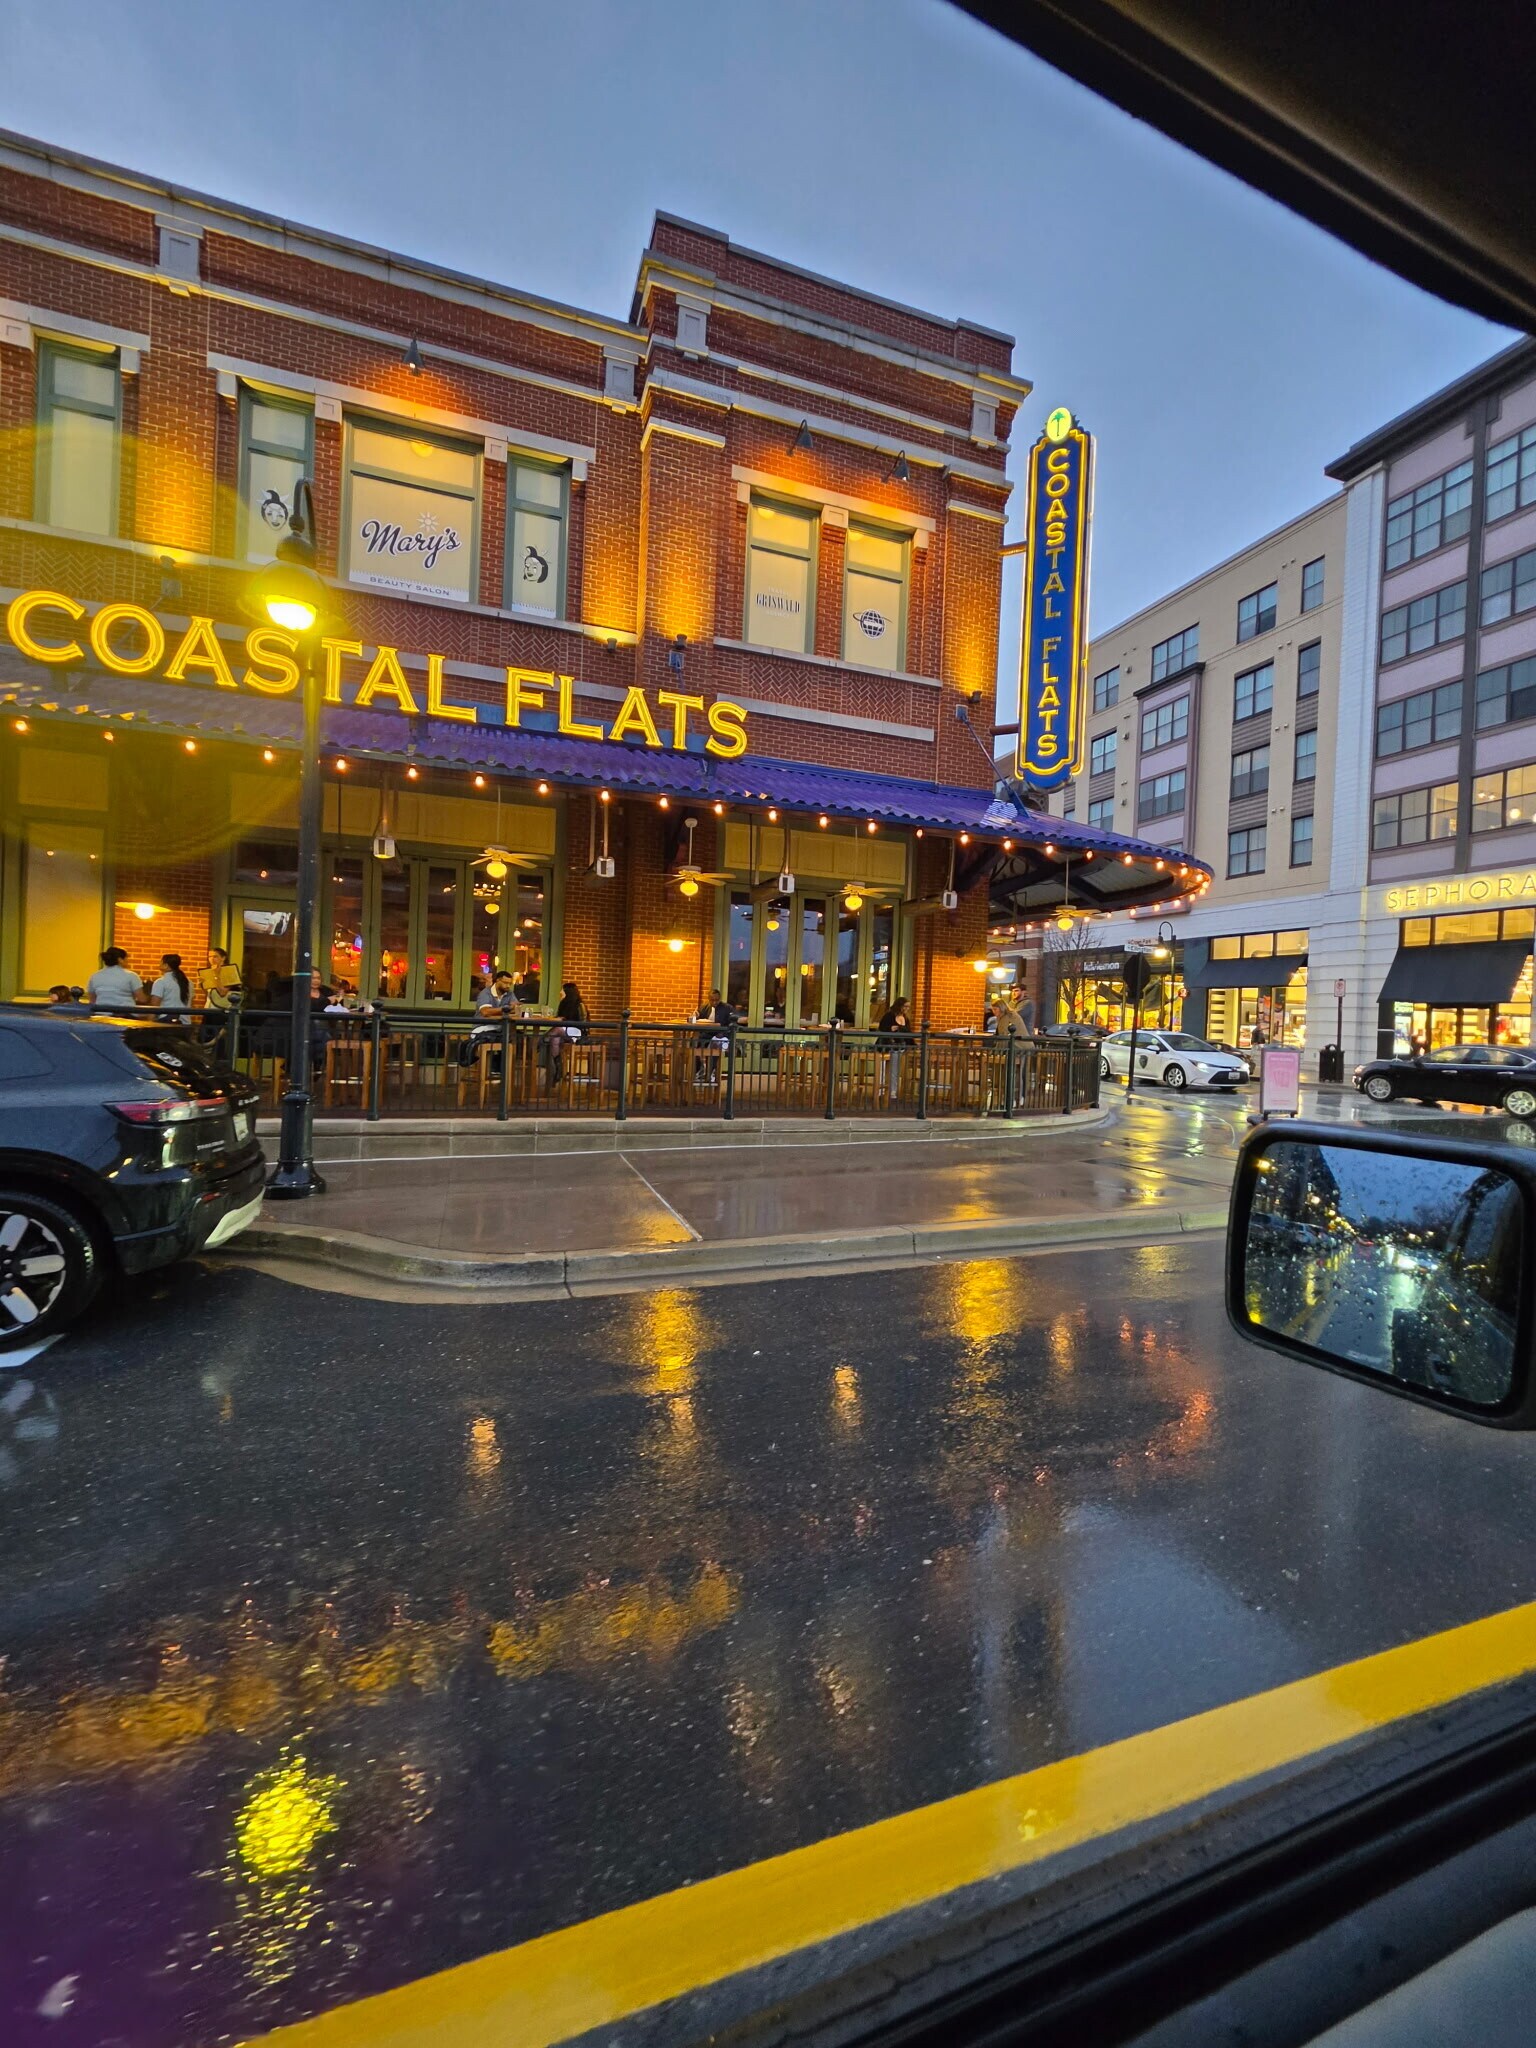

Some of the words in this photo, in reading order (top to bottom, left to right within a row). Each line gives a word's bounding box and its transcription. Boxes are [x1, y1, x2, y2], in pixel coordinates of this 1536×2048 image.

[361, 519, 461, 569] Mary's
[1043, 448, 1070, 619] COASTAL
[369, 576, 413, 589] BEAUTY
[415, 585, 450, 596] SALON
[7, 590, 477, 723] COASTAL
[504, 666, 748, 758] FLATS
[1037, 637, 1062, 757] FLATS
[1387, 874, 1536, 910] SEPHORA
